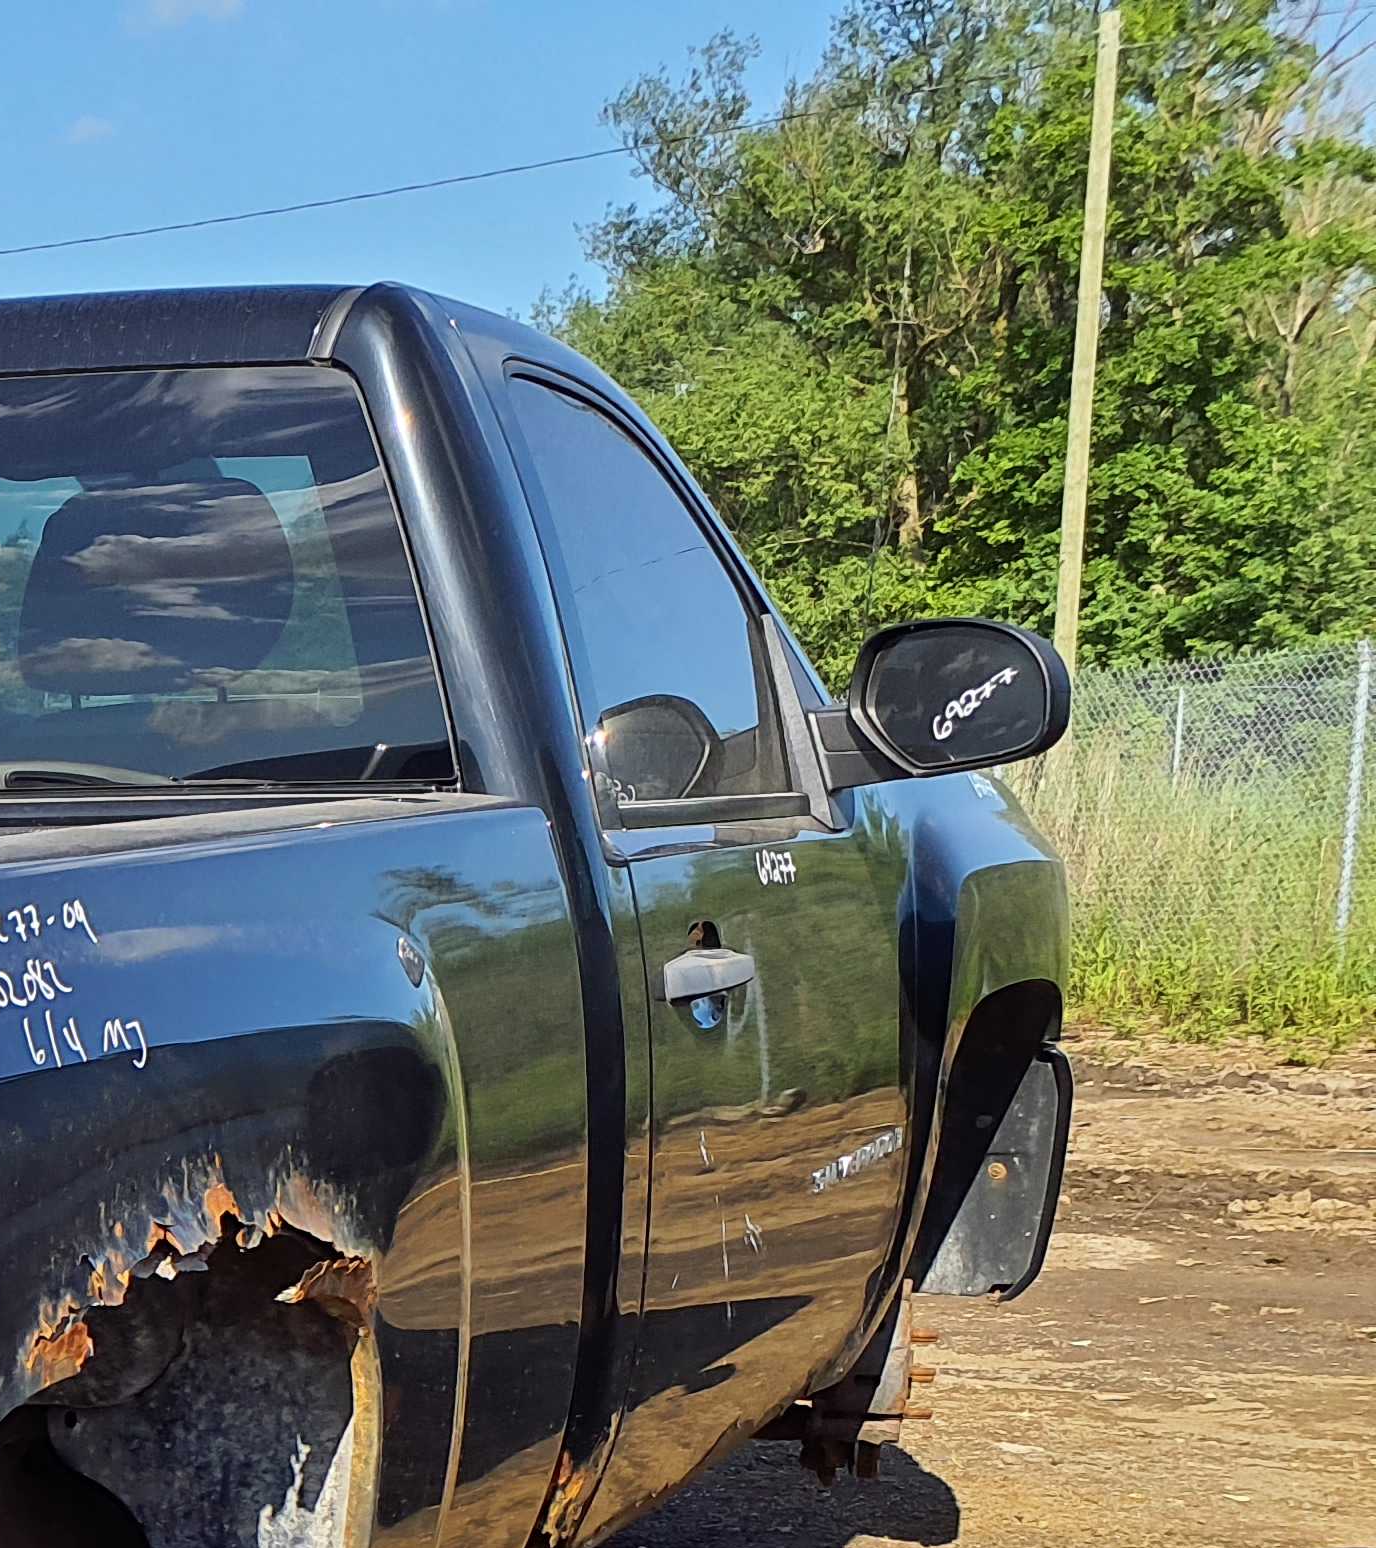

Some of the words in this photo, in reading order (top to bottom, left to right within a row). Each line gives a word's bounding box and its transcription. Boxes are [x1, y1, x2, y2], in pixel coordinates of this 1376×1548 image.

[933, 667, 1019, 741] 69277
[756, 849, 796, 885] 69277
[23, 1009, 88, 1068] 6/4
